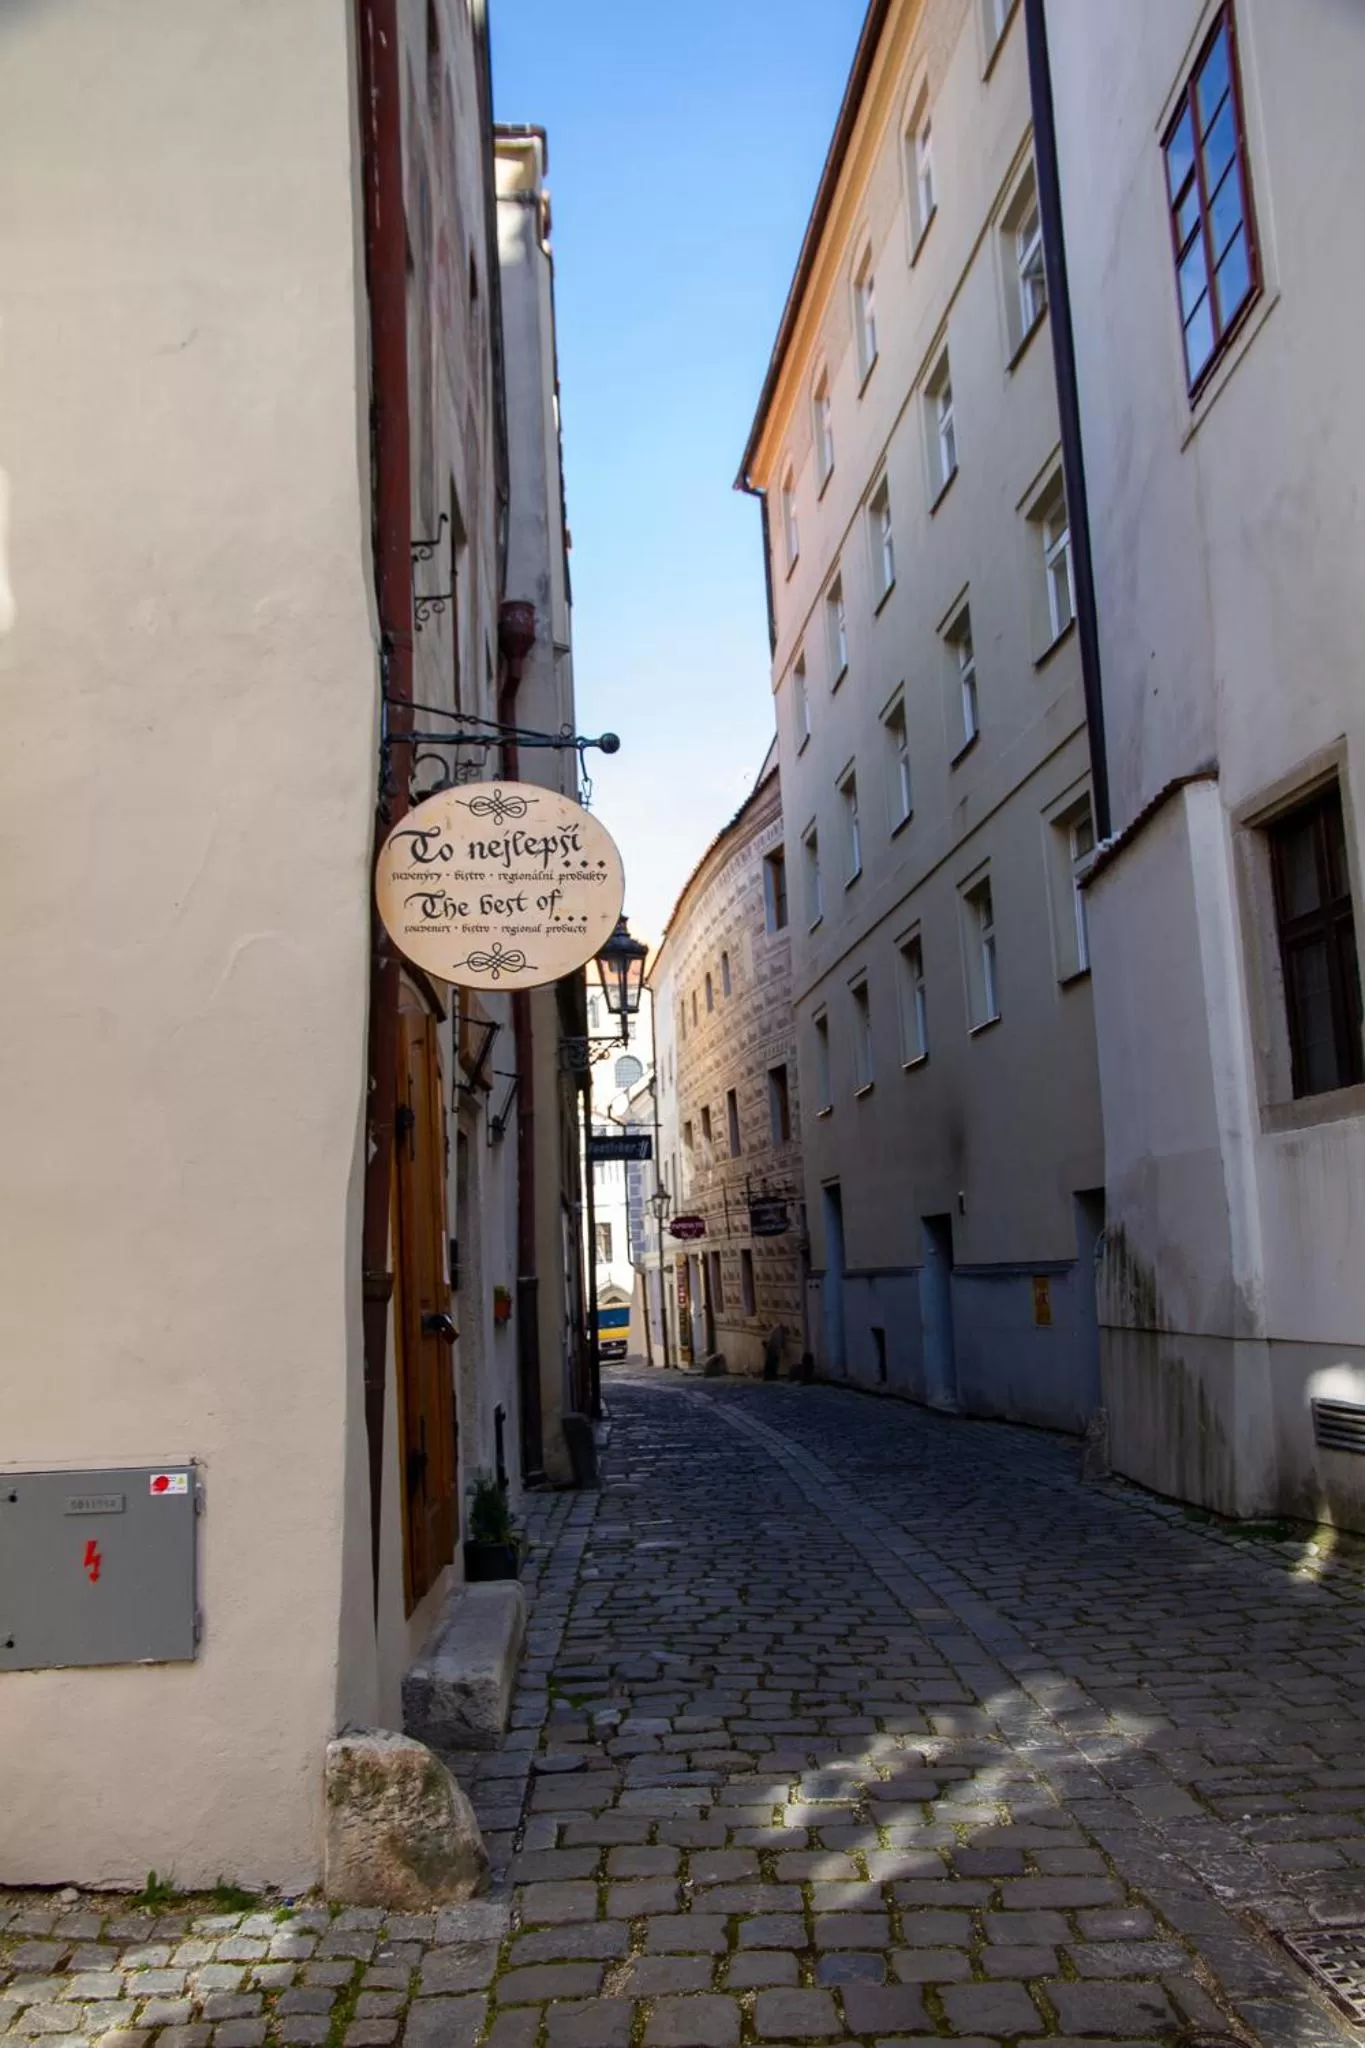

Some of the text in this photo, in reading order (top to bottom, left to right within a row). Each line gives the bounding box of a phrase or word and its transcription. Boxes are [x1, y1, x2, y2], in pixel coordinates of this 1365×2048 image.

[388, 826, 454, 870] To
[454, 870, 486, 881] bistro
[498, 869, 554, 884] regionální
[558, 870, 608, 886] produkty
[404, 890, 470, 923] The
[479, 890, 528, 917] best
[404, 923, 587, 937] souvenirs bistro regional products
